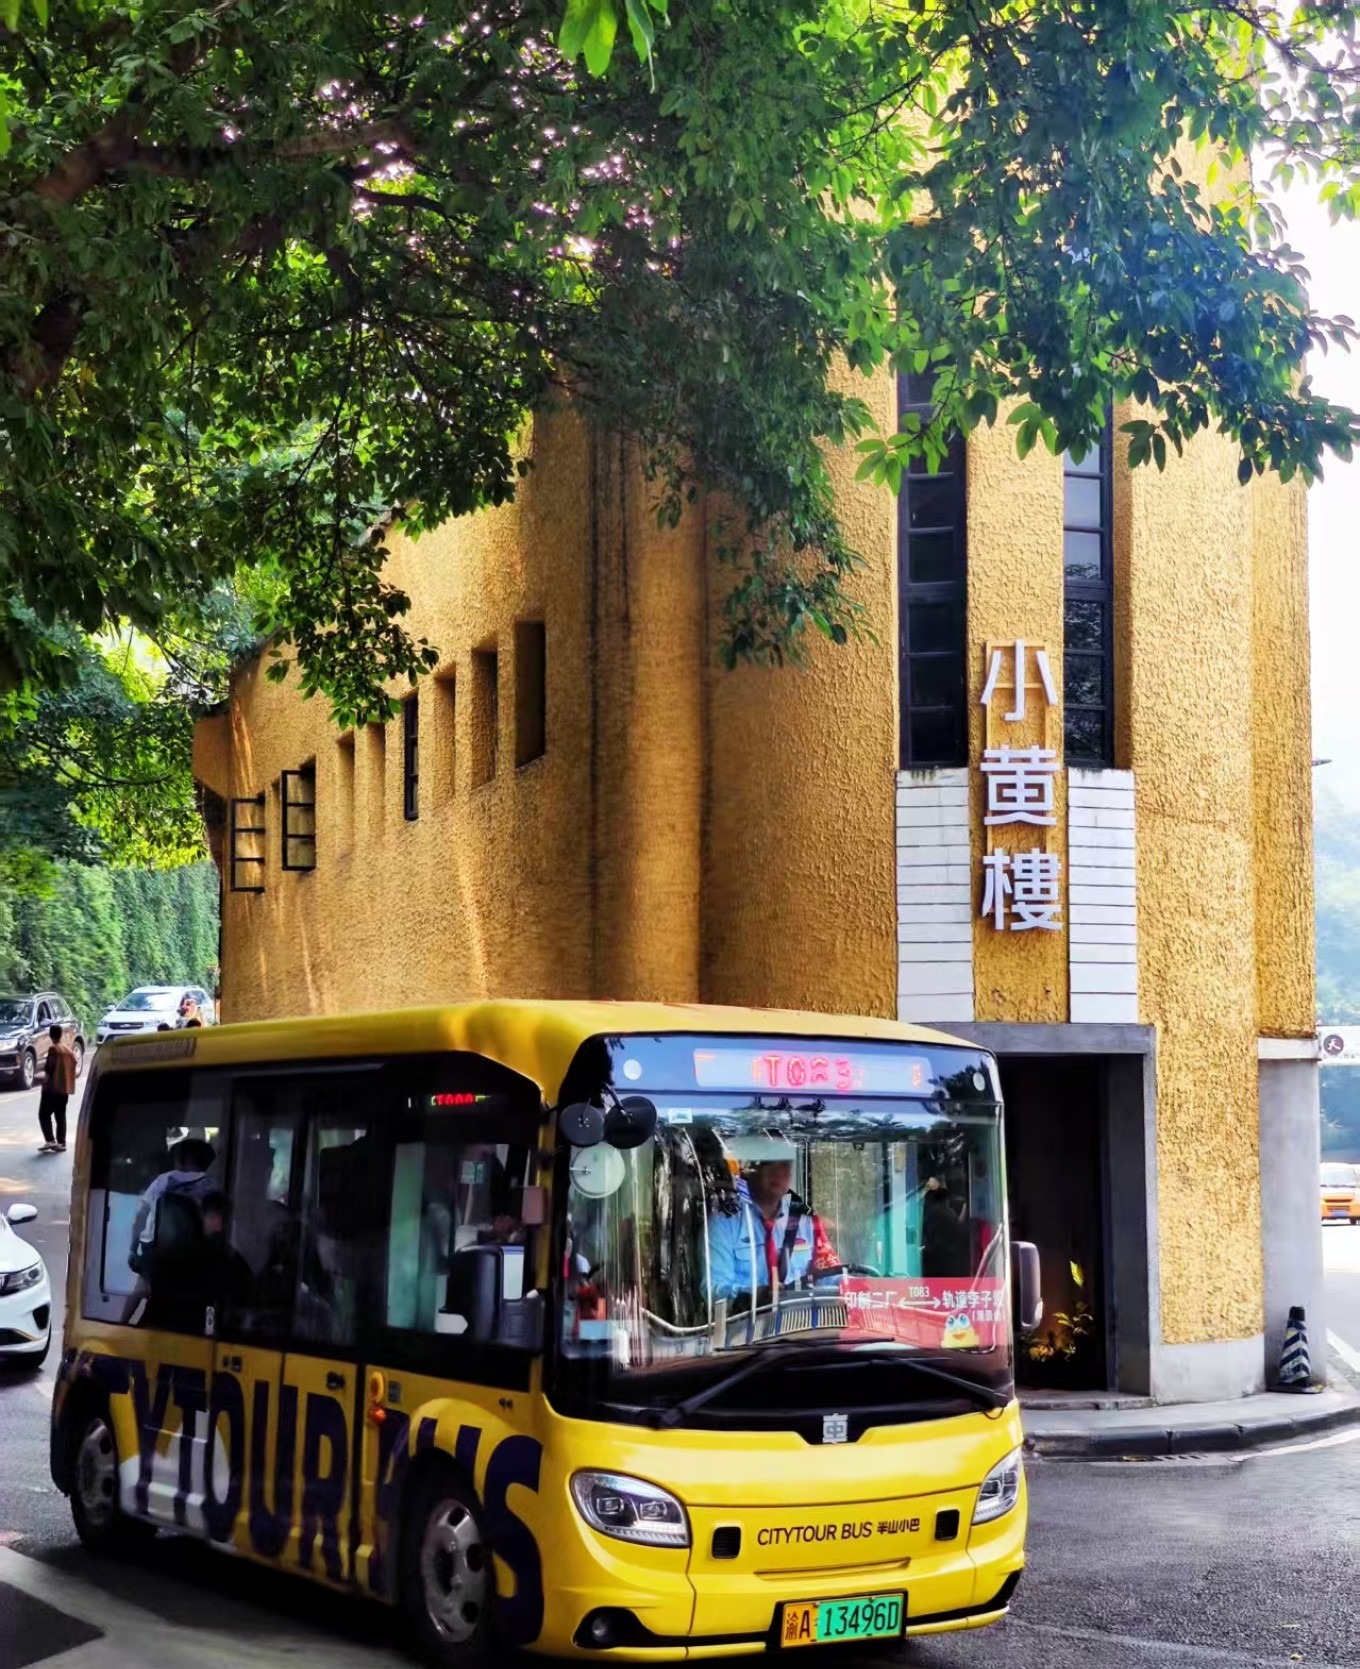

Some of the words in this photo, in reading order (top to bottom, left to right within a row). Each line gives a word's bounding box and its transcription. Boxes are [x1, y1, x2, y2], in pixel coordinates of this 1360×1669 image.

[908, 1286, 930, 1298] T083
[757, 1524, 837, 1546] CITYTOUR
[840, 1521, 873, 1540] BUS
[877, 1518, 921, 1535] 半山小巴
